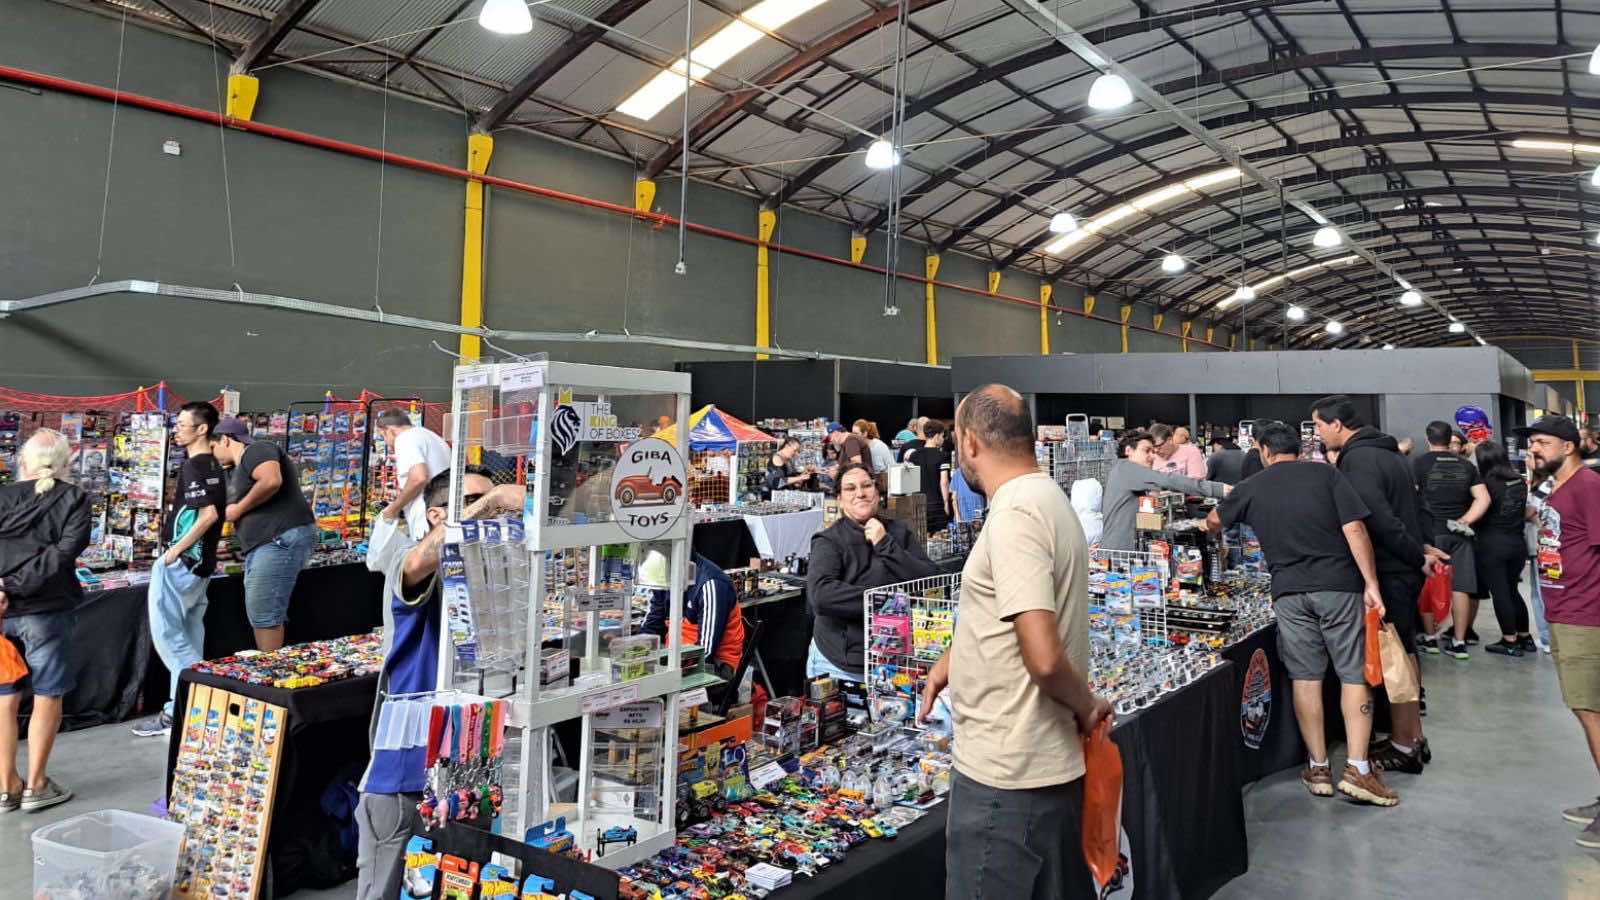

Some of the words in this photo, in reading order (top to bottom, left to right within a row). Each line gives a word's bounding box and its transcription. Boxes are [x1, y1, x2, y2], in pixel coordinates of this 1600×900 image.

[592, 403, 611, 415] THE
[590, 416, 617, 427] KING
[590, 429, 604, 439] OF
[606, 429, 637, 439] BOXES
[631, 450, 672, 465] GIBA
[628, 512, 669, 527] TOYS
